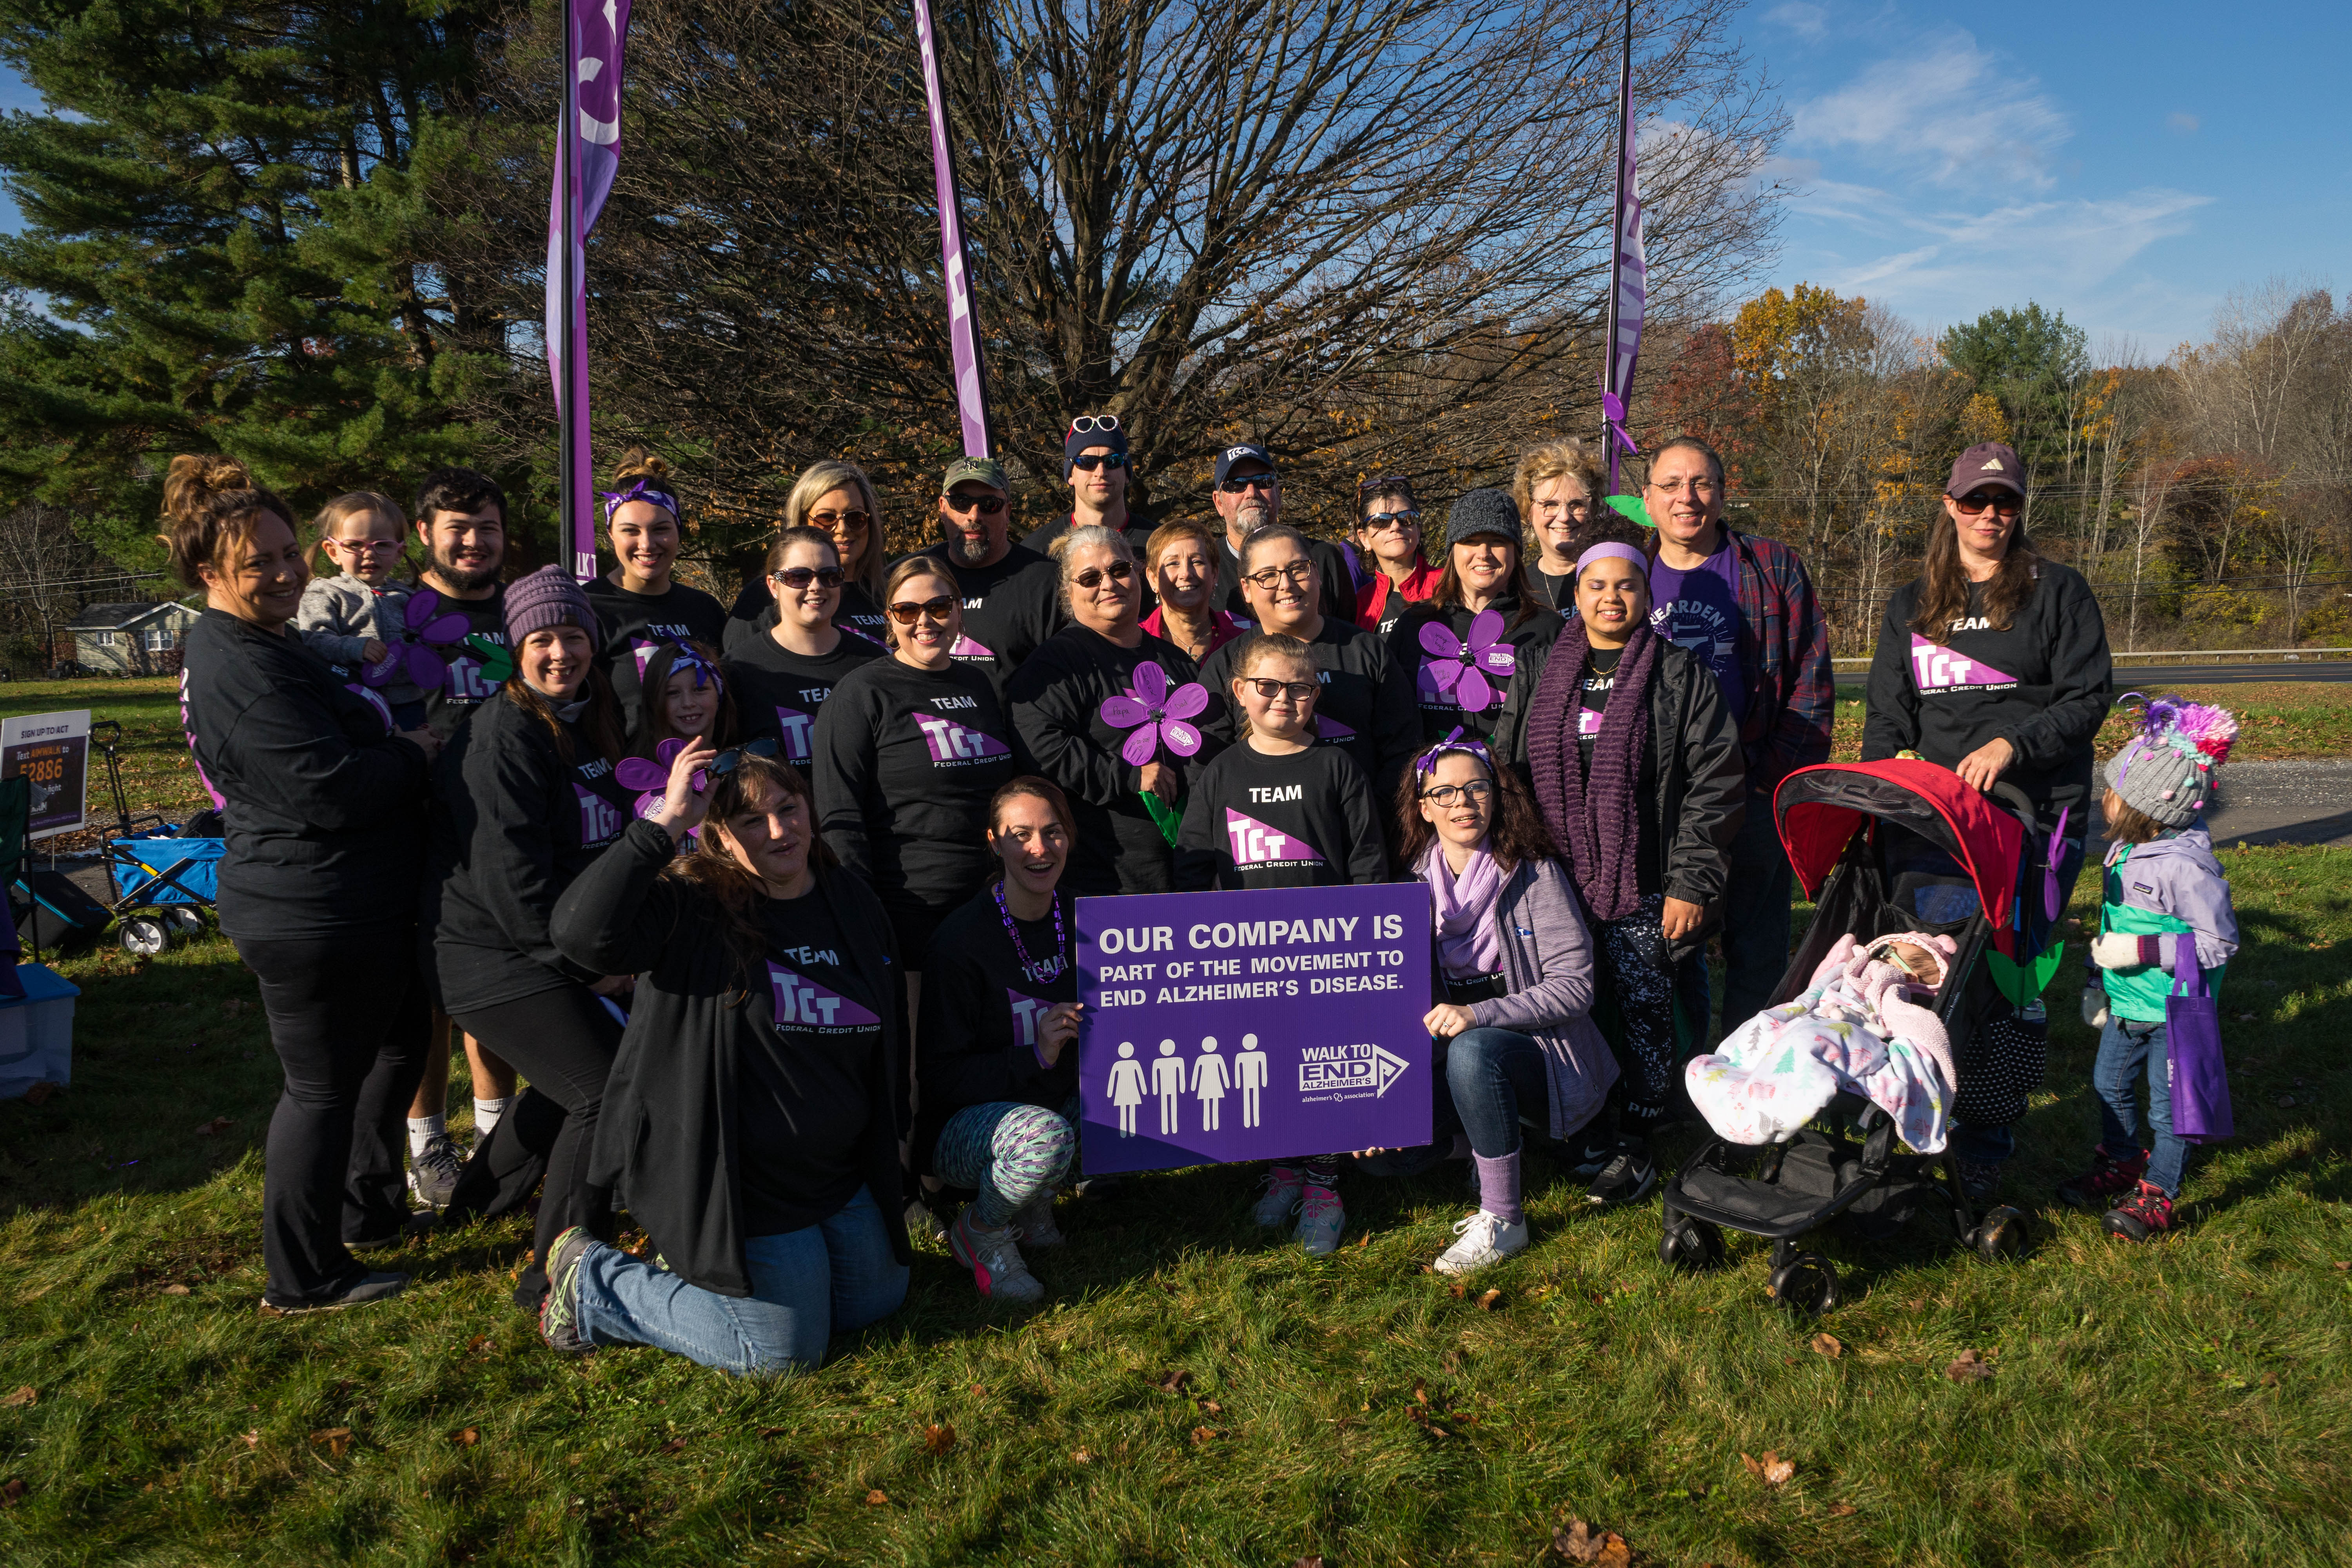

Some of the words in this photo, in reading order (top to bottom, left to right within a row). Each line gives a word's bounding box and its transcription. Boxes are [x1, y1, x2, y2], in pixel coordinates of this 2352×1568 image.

[1913, 645, 1971, 688] TCT
[930, 696, 977, 710] TEAM
[1113, 706, 1130, 719] Papa
[21, 730, 35, 739] SIGN
[36, 728, 45, 736] UP
[47, 727, 55, 735] TO
[56, 725, 69, 734] ACT
[921, 720, 984, 759] TCT
[1172, 730, 1187, 740] END
[17, 751, 30, 760] Text
[974, 756, 997, 765] CREDIT
[1249, 785, 1302, 803] TEAM
[1229, 818, 1286, 864] TCT
[1234, 863, 1263, 872] FEDERAL
[1100, 927, 1173, 954] OUR
[1189, 917, 1359, 949] COMPANY
[1374, 915, 1403, 939] IS
[784, 946, 840, 965] TEAM
[1100, 964, 1156, 982] PART
[1167, 962, 1194, 978] OF
[1200, 959, 1240, 976] THE
[1251, 952, 1372, 973] MOVEMENT
[1377, 950, 1403, 965] TO
[771, 972, 840, 1024] TCT
[1101, 989, 1146, 1007] END
[1157, 980, 1298, 1003] ALZHEIMER'S
[1311, 974, 1403, 994] DISEASE.
[1302, 1045, 1348, 1062] WALK
[1350, 1044, 1370, 1058] TO
[1303, 1062, 1371, 1081] END
[1302, 1078, 1371, 1089] ALZHEIMER'S
